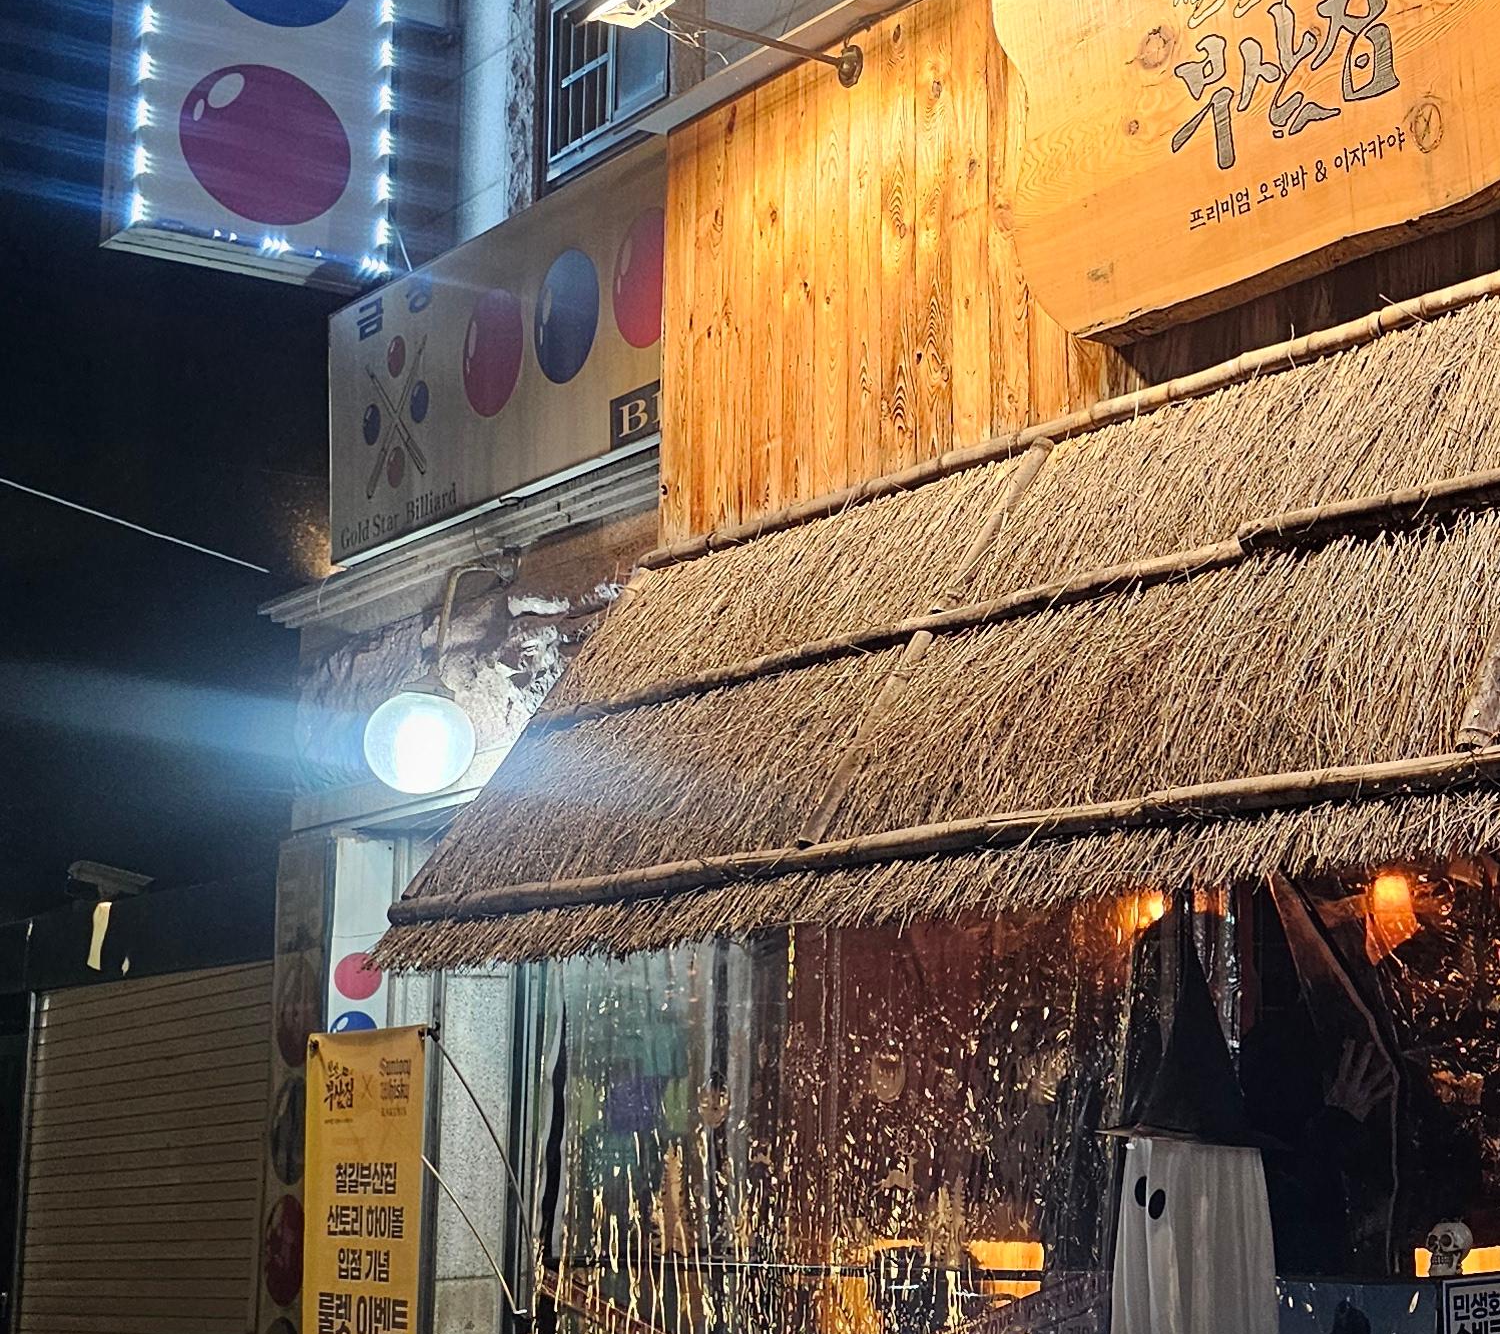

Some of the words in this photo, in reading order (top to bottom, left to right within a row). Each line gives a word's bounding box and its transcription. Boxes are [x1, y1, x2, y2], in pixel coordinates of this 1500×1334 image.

[1189, 188, 1251, 230] 프리미엄
[1256, 166, 1308, 205] 오뎅바
[1315, 160, 1328, 181] &
[1334, 126, 1406, 172] 이자카야
[341, 516, 370, 551] Gold
[372, 505, 401, 540] Star
[405, 482, 457, 524] Billiard
[335, 1162, 397, 1194] 철길부산집
[327, 1204, 363, 1237] 산토리
[366, 1205, 404, 1239] 하이볼
[338, 1248, 362, 1280] 입점
[365, 1249, 391, 1283] 기념
